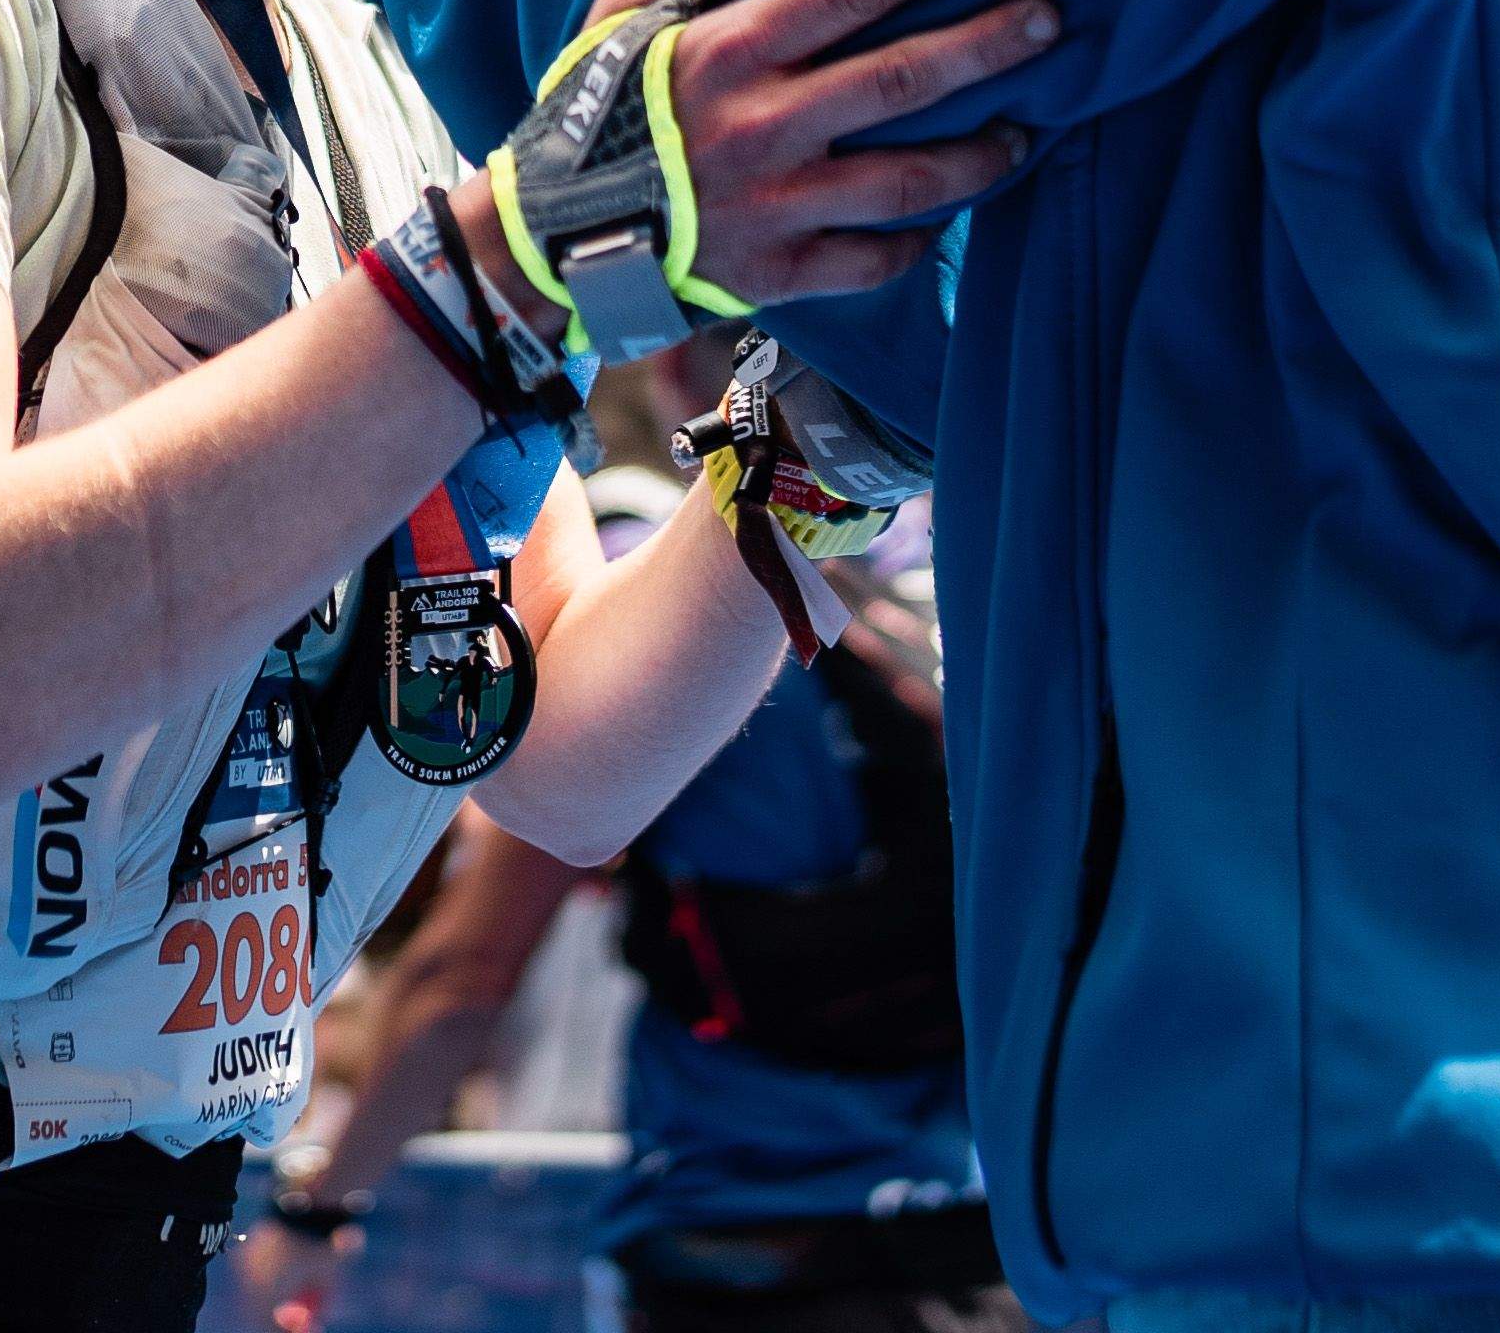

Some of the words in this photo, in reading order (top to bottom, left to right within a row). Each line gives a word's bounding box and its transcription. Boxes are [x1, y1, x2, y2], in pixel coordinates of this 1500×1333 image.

[562, 39, 627, 143] LEKI
[752, 352, 769, 370] LEFT
[434, 588, 461, 599] TRAIL
[462, 586, 479, 596] 100
[434, 596, 479, 608] ANDORRA
[386, 745, 415, 773] TRAIL
[418, 767, 452, 781] 50KM
[456, 736, 507, 778] FINISHER
[234, 763, 247, 781] BY
[208, 1027, 295, 1086] JUDITH
[195, 1085, 257, 1125] MARÍN
[29, 1119, 69, 1141] 50K
